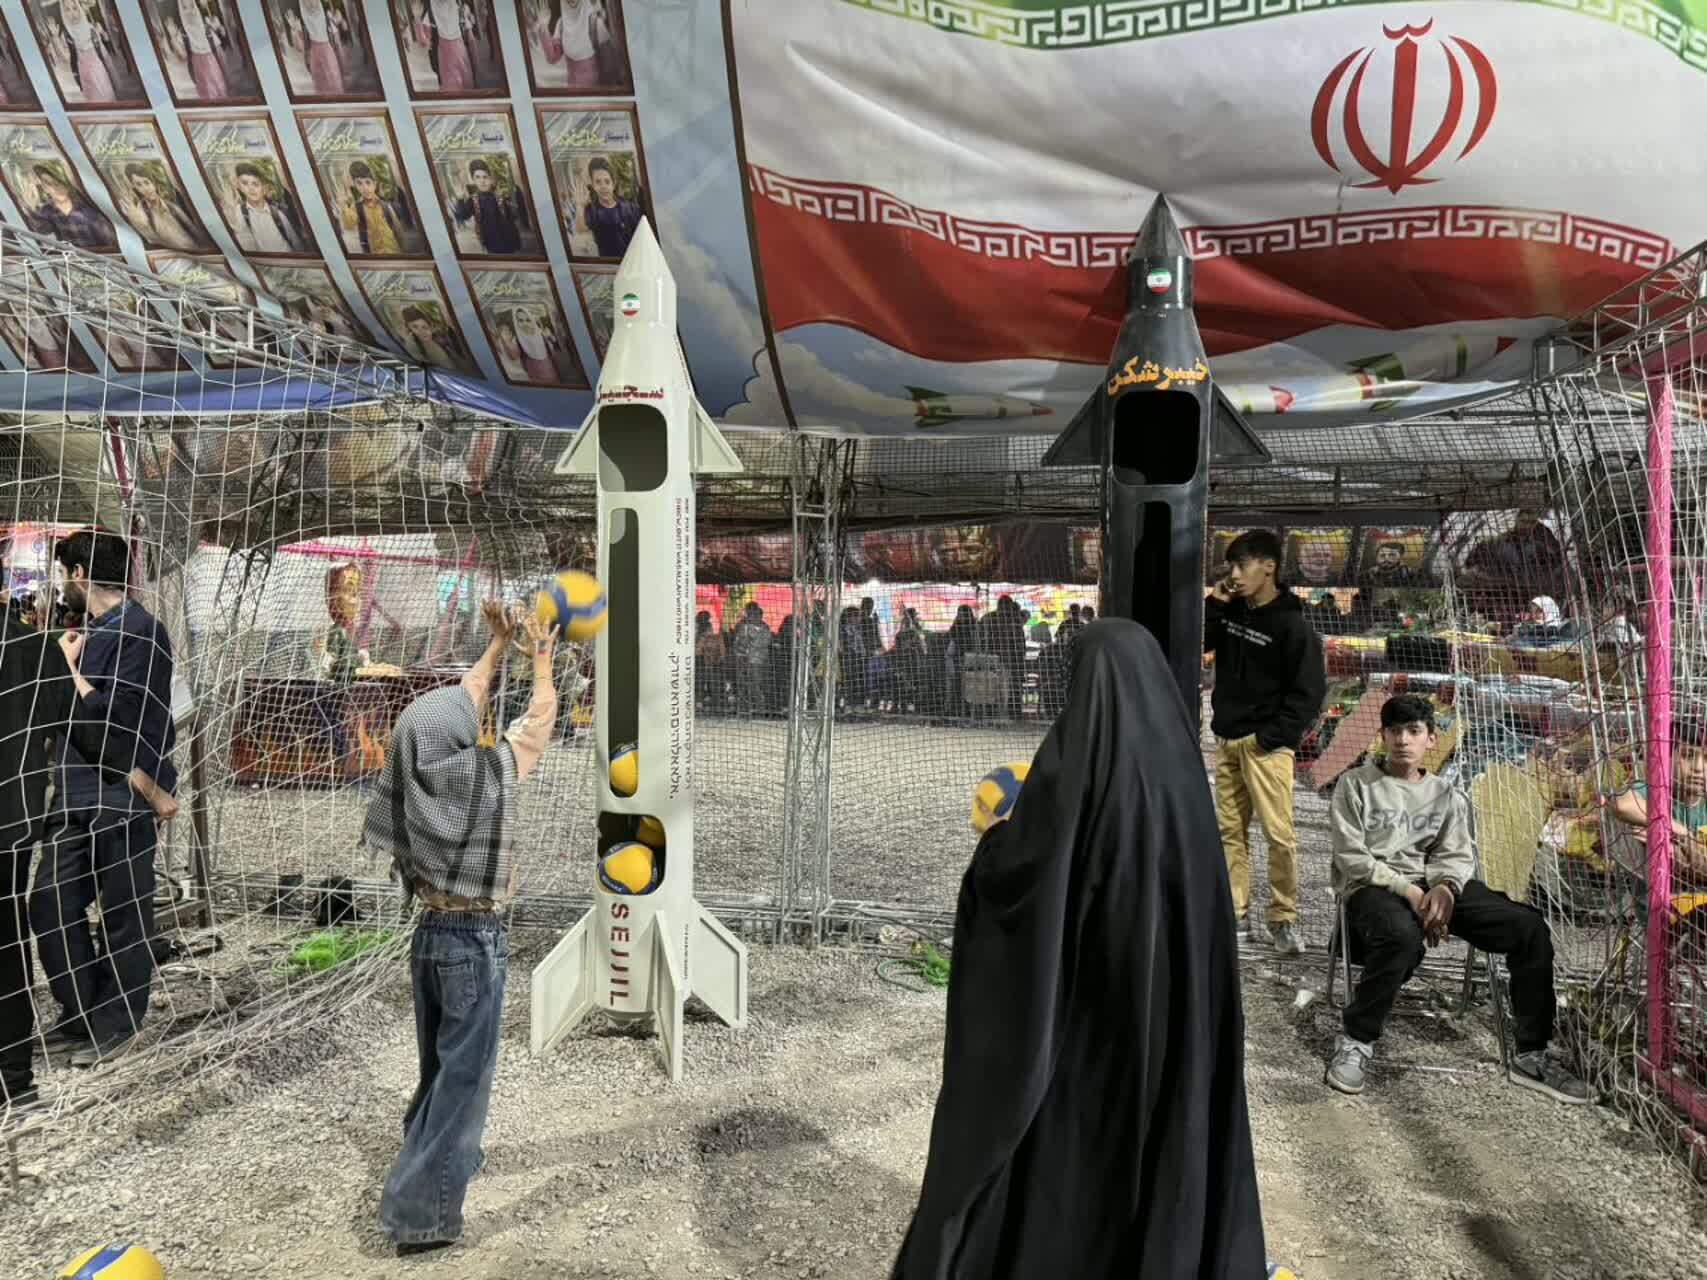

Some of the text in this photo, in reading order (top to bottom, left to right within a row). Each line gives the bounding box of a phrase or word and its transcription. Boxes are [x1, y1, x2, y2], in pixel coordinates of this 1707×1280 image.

[1108, 355, 1209, 395] خیبر شکن
[610, 902, 630, 1007] SEJJIL
